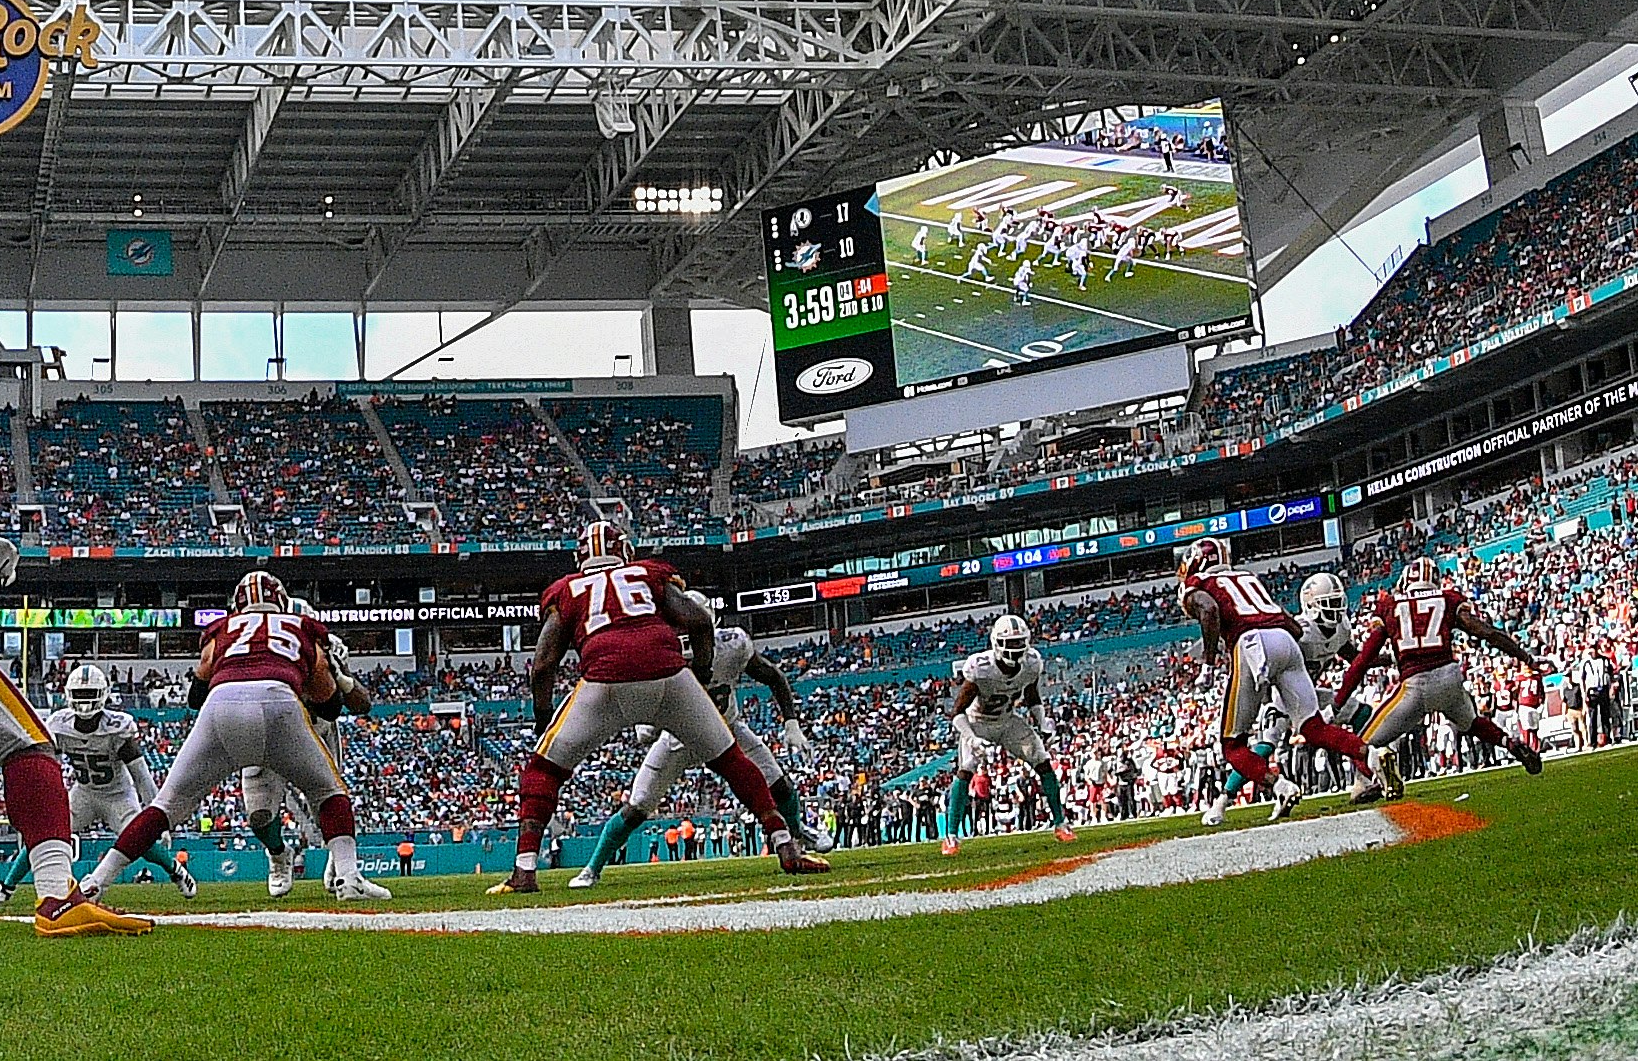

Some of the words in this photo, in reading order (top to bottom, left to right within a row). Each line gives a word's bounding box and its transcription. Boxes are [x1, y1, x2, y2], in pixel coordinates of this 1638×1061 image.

[836, 202, 849, 223] 17
[839, 237, 854, 258] 10
[784, 286, 835, 329] 3:59
[839, 300, 858, 318] 2ND
[871, 295, 884, 312] 10
[813, 365, 856, 389] Ford
[1367, 472, 1404, 497] HELLAS
[1404, 443, 1481, 483] CONSTRUCTION
[1483, 425, 1531, 454] OFFICIAL
[1532, 404, 1583, 435] PARTNER
[1584, 396, 1600, 416] OF
[1603, 388, 1626, 409] THE
[1181, 454, 1196, 466] 39
[847, 514, 862, 525] 40
[1287, 501, 1315, 518] pepsi
[547, 540, 562, 551] 84
[693, 535, 706, 545] 13
[961, 560, 980, 575] 20
[1015, 549, 1042, 565] 104
[1075, 540, 1099, 556] 5.2
[1144, 529, 1156, 544] 0
[1209, 517, 1228, 532] 25
[228, 548, 244, 557] 54
[568, 566, 657, 636] 76
[763, 589, 790, 605] 3:59
[1216, 575, 1283, 616] 10
[418, 607, 483, 620] OFFICIAL
[487, 604, 540, 621] PARTNE
[1393, 597, 1446, 651] 17
[225, 613, 302, 659] 75
[65, 752, 115, 786] 55
